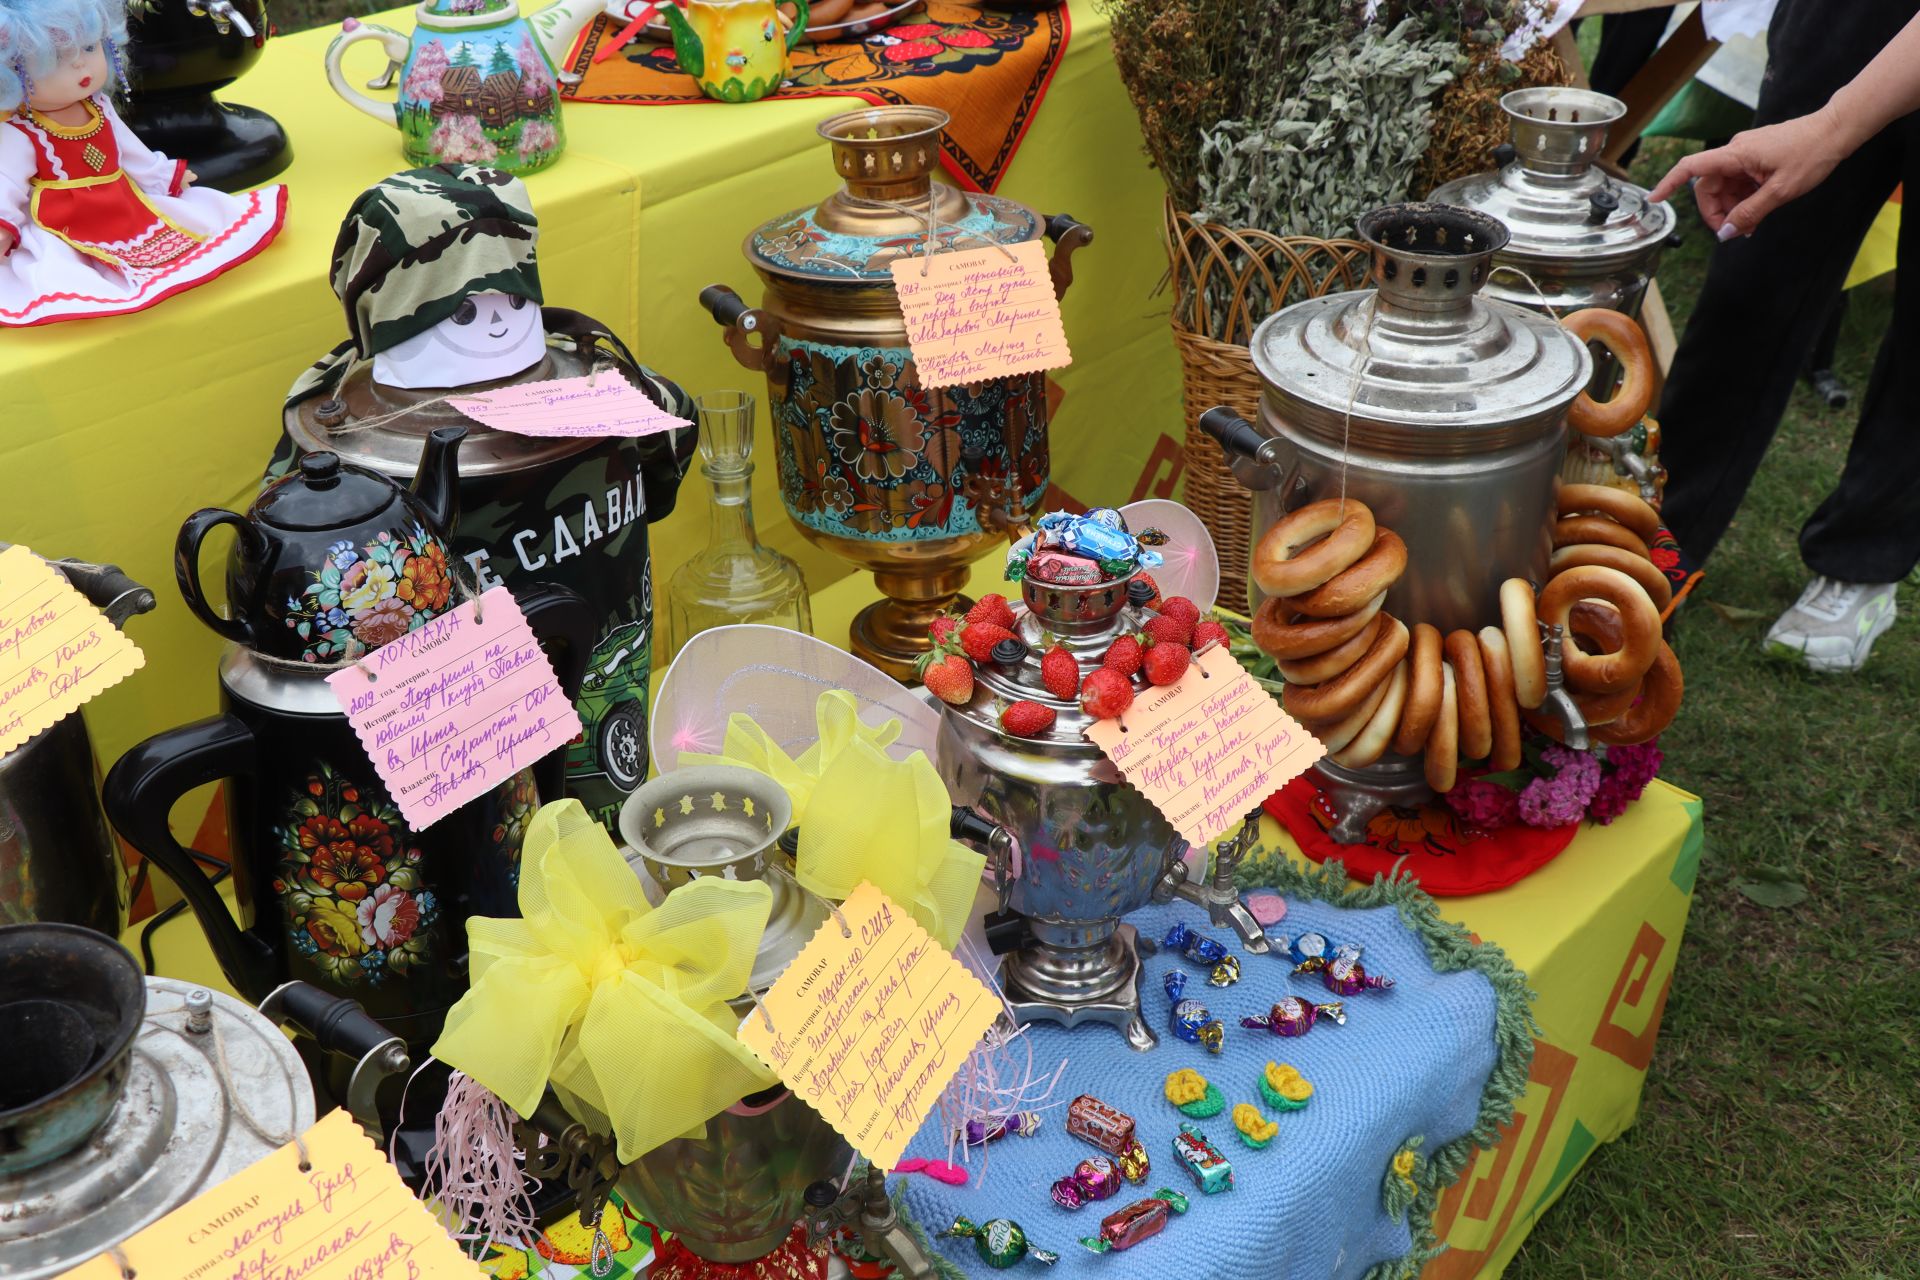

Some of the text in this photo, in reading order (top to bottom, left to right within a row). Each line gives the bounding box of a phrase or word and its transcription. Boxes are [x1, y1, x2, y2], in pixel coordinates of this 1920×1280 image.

[949, 259, 987, 271] САМОВАР
[1000, 279, 1035, 299] купил
[911, 316, 916, 325] и
[970, 298, 1013, 318] внучке
[987, 309, 1050, 333] Марине
[975, 339, 1024, 358] Марина
[938, 364, 985, 382] Старые
[464, 549, 504, 593] Е
[411, 632, 451, 658] САМОВАР
[350, 668, 430, 715] 2019 год, материал
[363, 644, 508, 730] История: Подарили на
[1148, 685, 1183, 713] САМОВАР
[376, 706, 426, 747] юбилей
[447, 678, 484, 706] клуба
[1124, 752, 1153, 775] История:
[1201, 673, 1250, 718] бабушкой
[1143, 718, 1172, 740] материал
[1195, 731, 1210, 746] на
[423, 717, 551, 807] Павлова Ирина
[400, 771, 437, 795] Владелец:
[1172, 801, 1202, 824] Владелец:
[1204, 754, 1257, 805] Ахметова
[1178, 772, 1187, 788] в
[796, 958, 828, 998] САМОВАР
[798, 1005, 823, 1036] материал
[862, 903, 893, 945] США
[792, 1056, 815, 1084] История:
[809, 1032, 856, 1096] Подарили
[858, 1110, 880, 1140] Владелец:
[920, 992, 960, 1050] Ирина
[308, 1163, 357, 1213] Тула
[188, 1194, 261, 1245] САМОВАР
